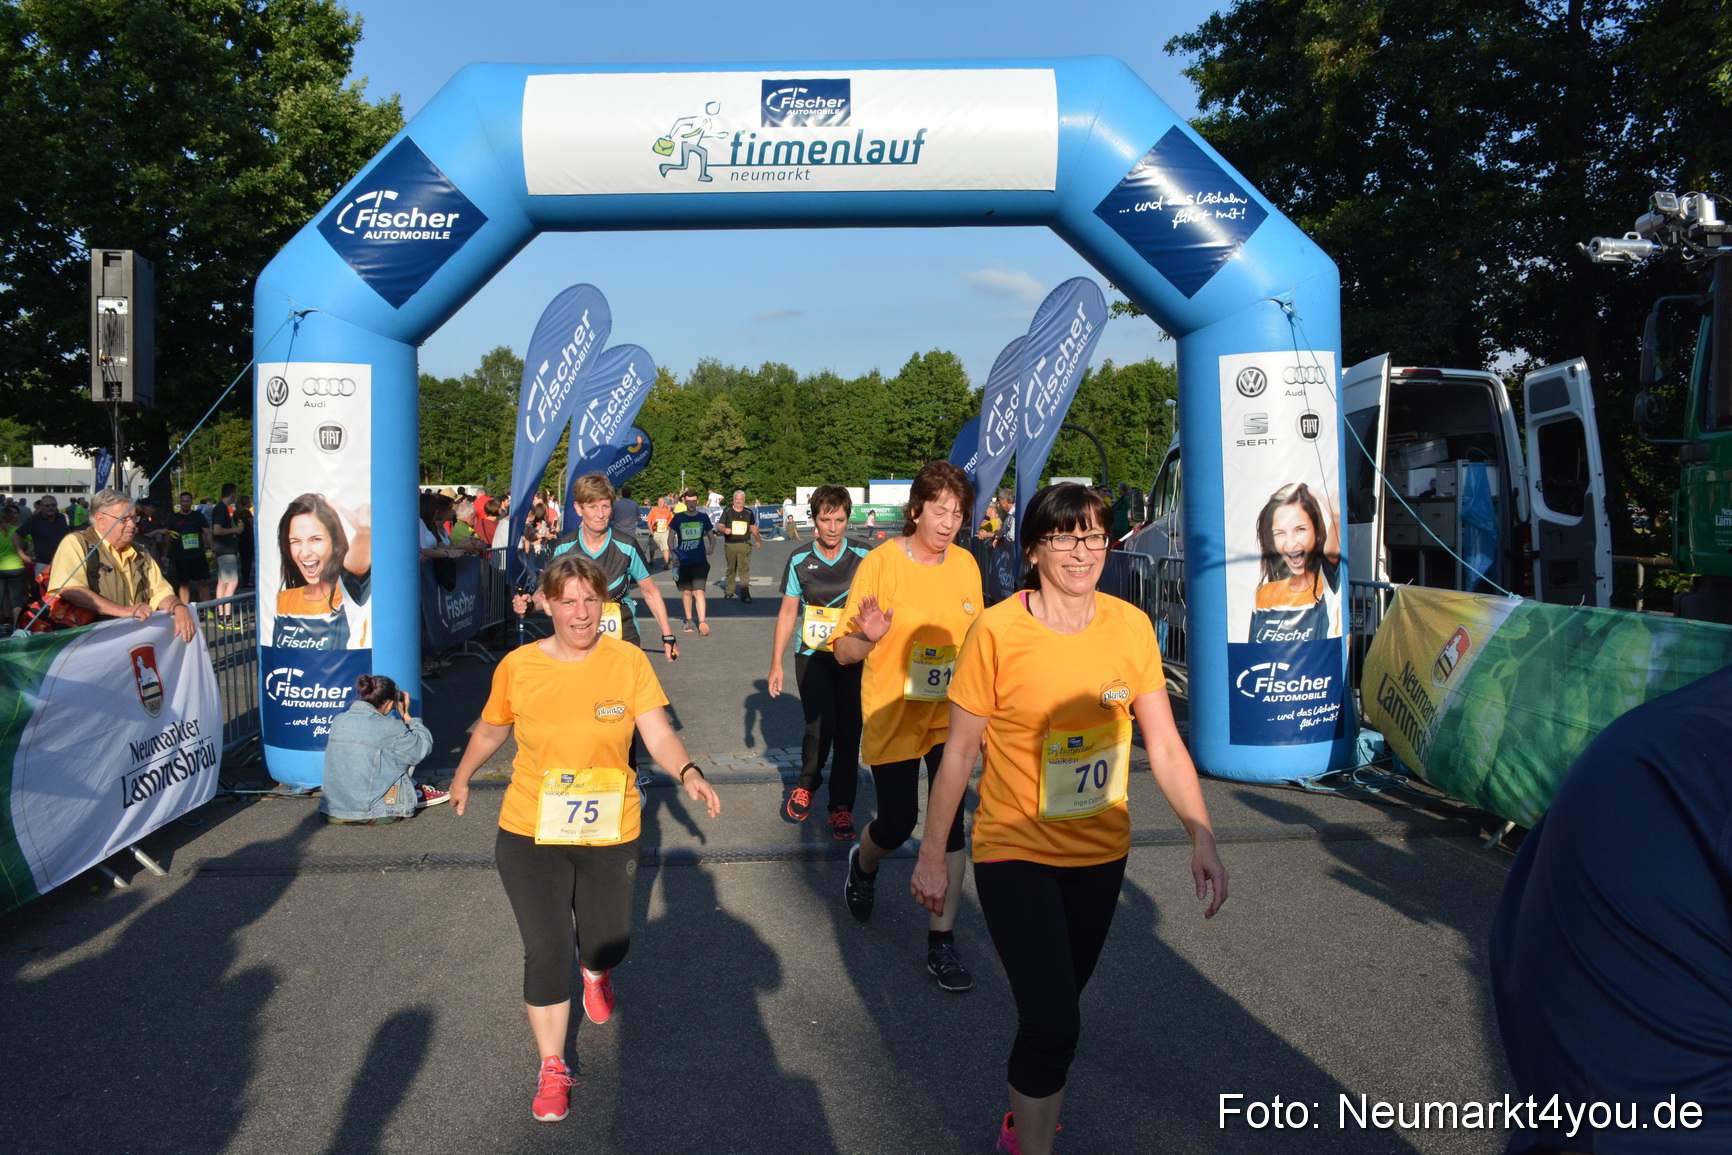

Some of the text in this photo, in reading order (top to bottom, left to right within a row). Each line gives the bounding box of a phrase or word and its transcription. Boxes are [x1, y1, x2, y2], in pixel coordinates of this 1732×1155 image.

[780, 96, 846, 109] Fischer
[729, 127, 928, 165] firmenlauf
[730, 167, 811, 182] neumarkt
[1134, 195, 1163, 212] und
[1196, 190, 1248, 205] Lächeln
[355, 207, 459, 229] Fischer
[1171, 207, 1246, 229] fährt mit!
[363, 230, 451, 240] AUTOMOBILE
[537, 309, 592, 424] Fischer
[1035, 301, 1088, 420] Fischer
[1049, 320, 1093, 417] AUTOMOBILE
[550, 329, 596, 423] AUTOMOBILE
[1284, 389, 1306, 397] Audi
[303, 400, 326, 408] Audi
[589, 361, 639, 446] Fischer
[605, 376, 644, 444] AUTOMOBILE
[1302, 418, 1318, 434] FIAT
[321, 430, 341, 445] FIAT
[1236, 438, 1277, 447] SEAT
[265, 447, 295, 455] SEAT
[684, 528, 698, 536] 681
[445, 591, 476, 620] Fischer
[281, 634, 329, 651] Fischer
[1262, 627, 1314, 642] Fischer
[927, 667, 952, 686] 81
[1254, 675, 1332, 693] Fischer
[276, 680, 353, 699] Fischer
[1262, 690, 1328, 703] AUTOMOBILE
[281, 699, 346, 708] AUTOMOBILE
[292, 716, 309, 727] und
[310, 714, 327, 725] das
[1276, 710, 1295, 721] und
[1296, 707, 1312, 717] das
[129, 718, 201, 766] Neumarkter
[120, 740, 217, 809] Lammsbräu
[1075, 759, 1108, 794] 70
[566, 800, 599, 824] 75
